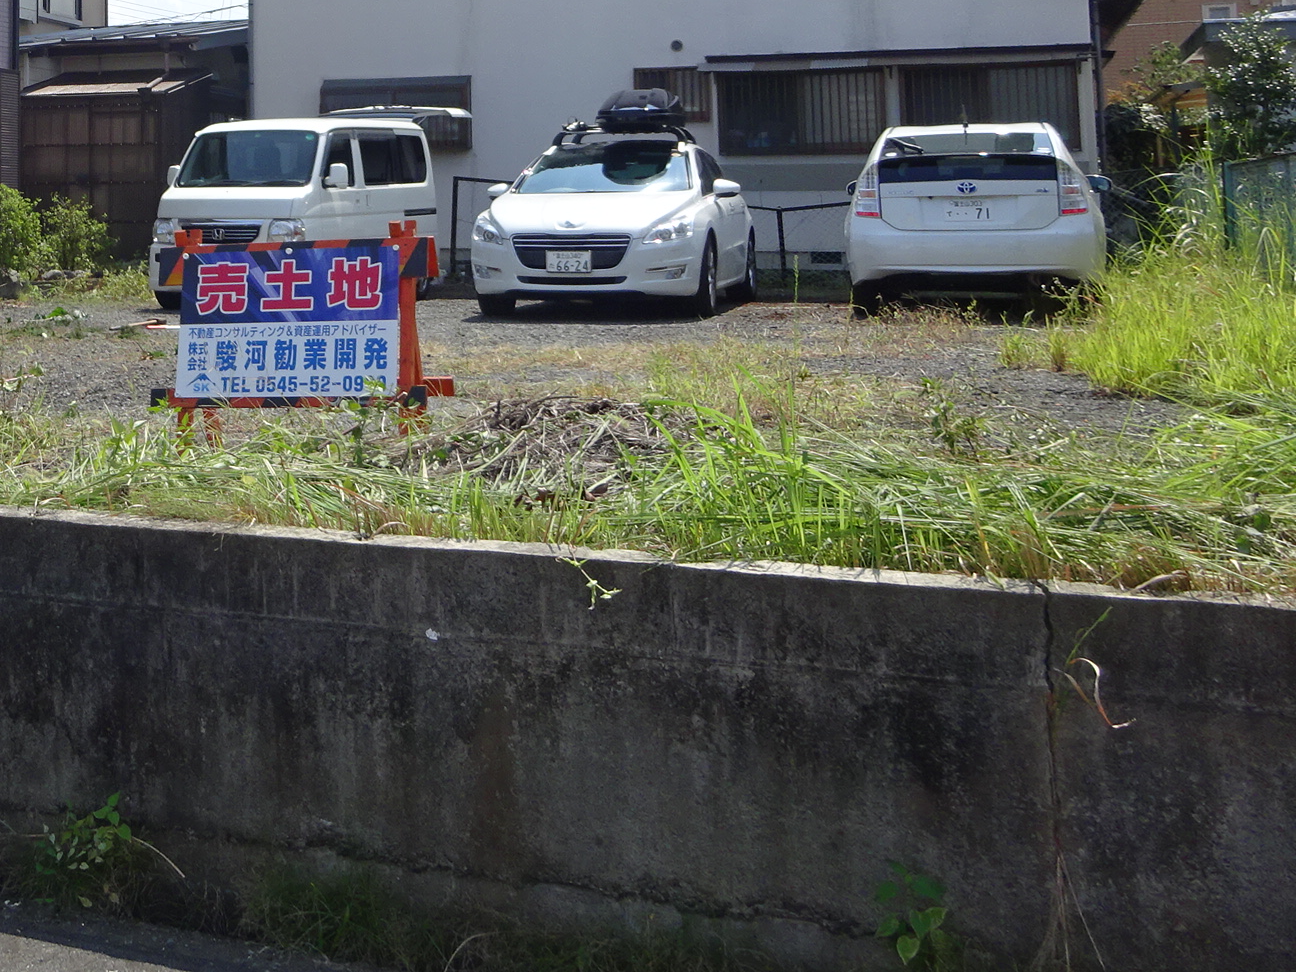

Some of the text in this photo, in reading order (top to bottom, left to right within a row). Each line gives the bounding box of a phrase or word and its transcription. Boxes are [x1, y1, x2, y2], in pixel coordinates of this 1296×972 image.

[975, 208, 990, 219] 71
[556, 260, 588, 271] 66-24
[196, 256, 382, 315] 売土地
[215, 338, 388, 371] 駿河勧業開発
[193, 383, 209, 392] SK
[221, 374, 386, 393] TEL 0545-52-09
